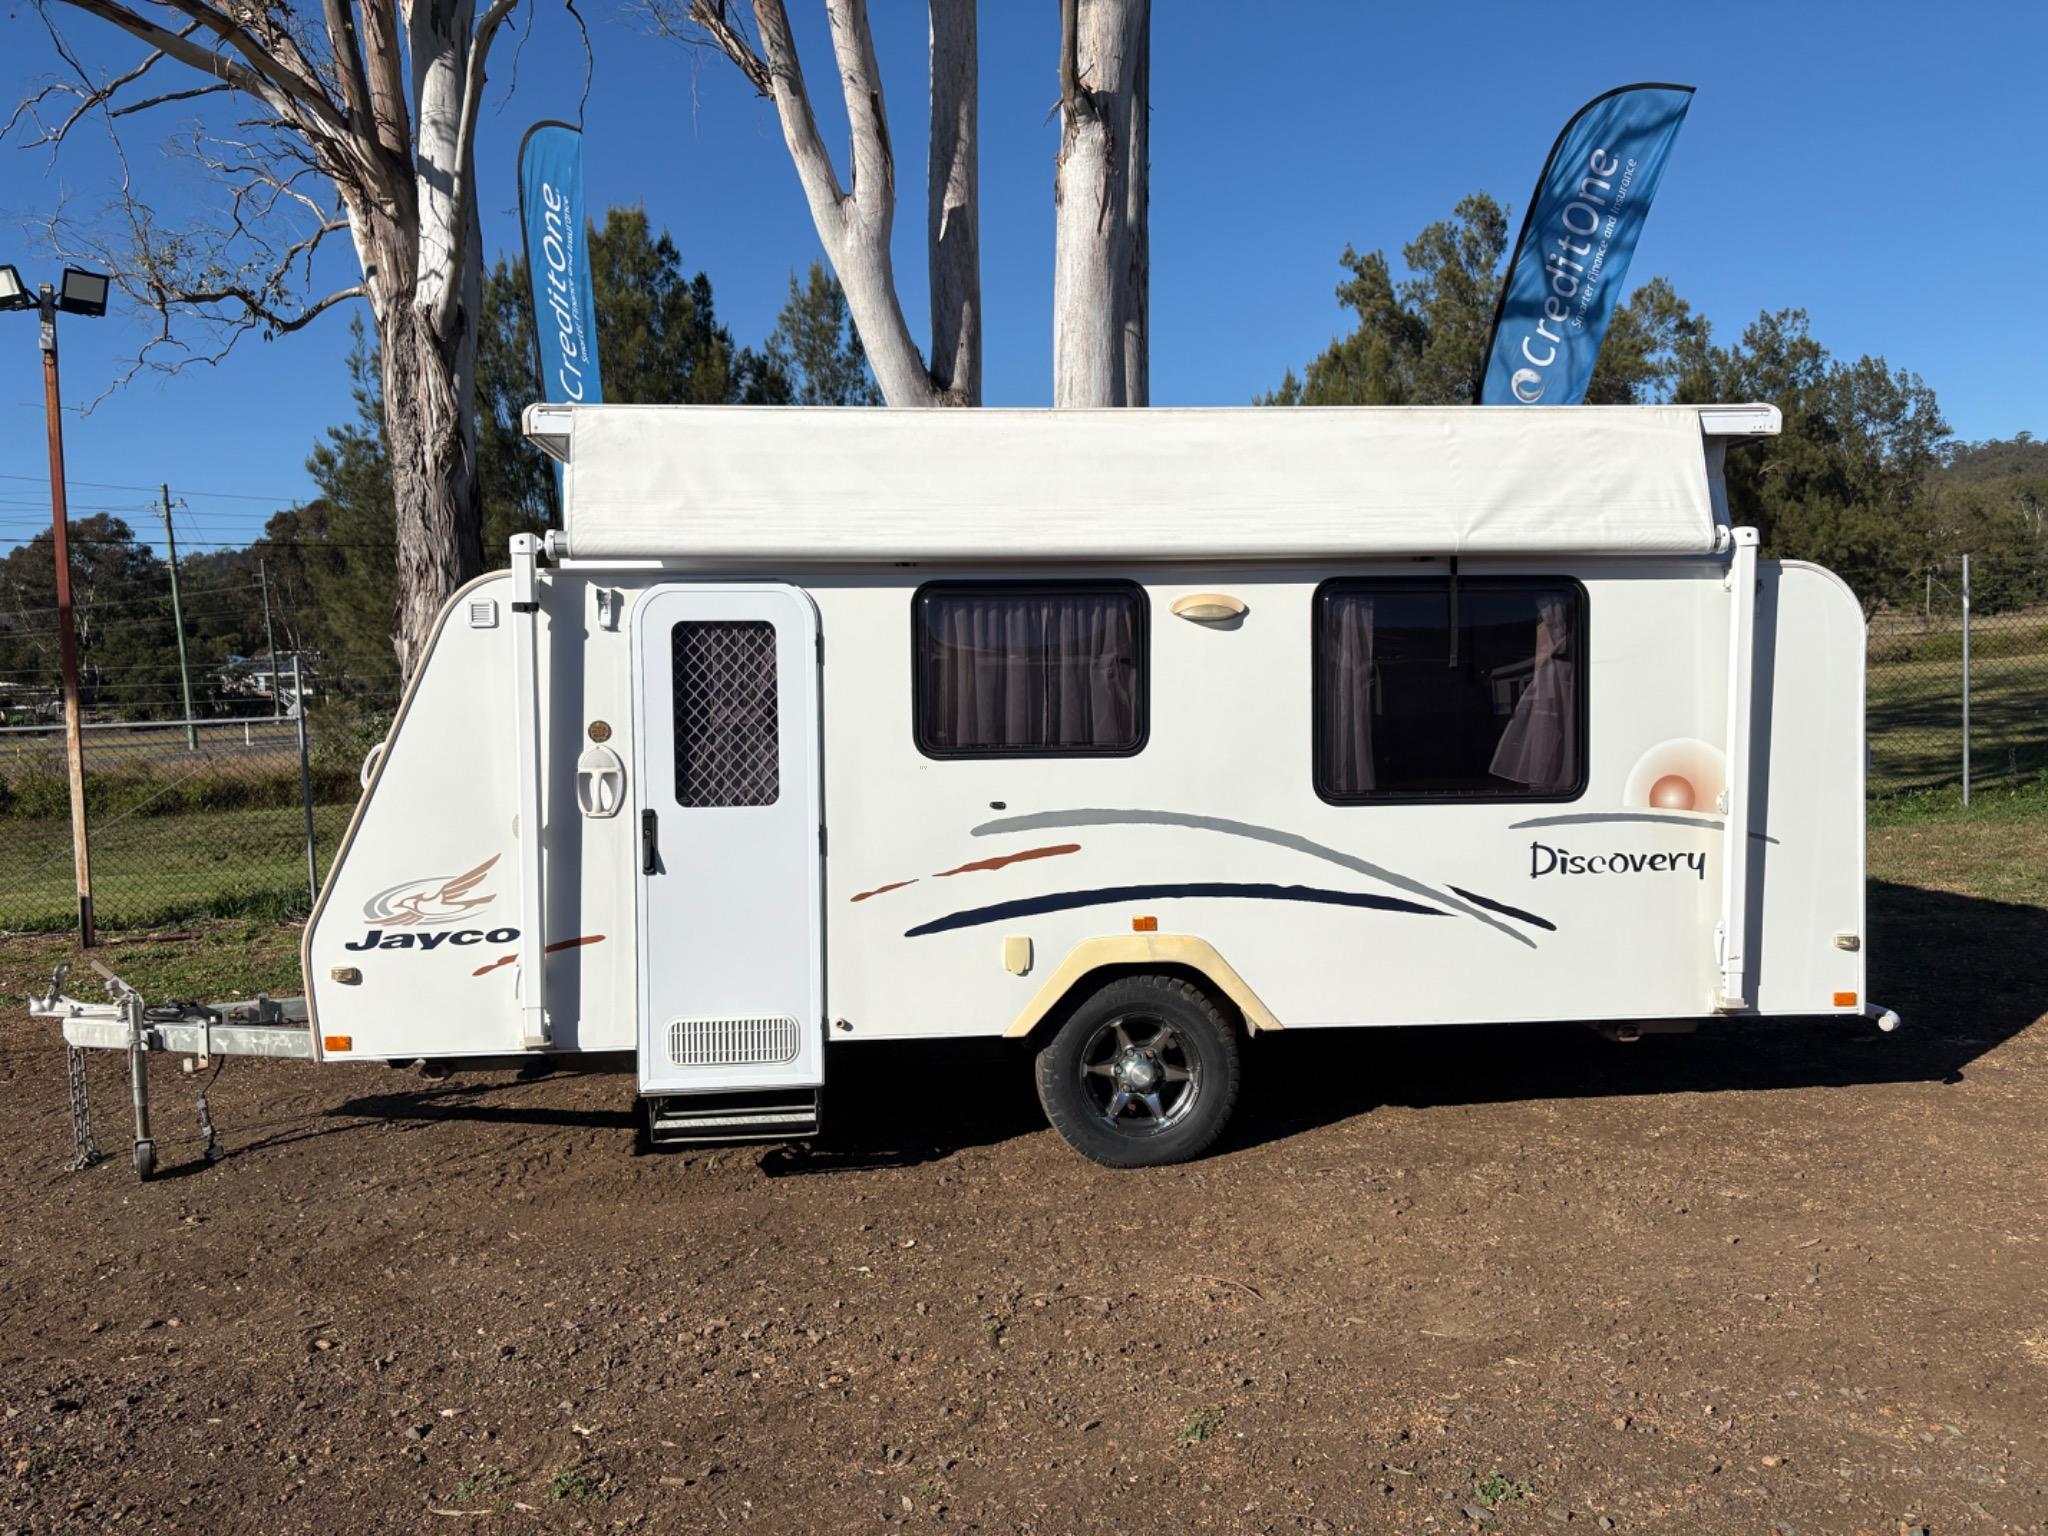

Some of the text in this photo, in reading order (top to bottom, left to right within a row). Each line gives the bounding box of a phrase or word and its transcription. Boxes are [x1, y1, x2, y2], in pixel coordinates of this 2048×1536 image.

[1571, 158, 1638, 329] Smarter Finance and Insurance
[1530, 841, 1706, 880] Discovery
[345, 927, 521, 951] Jayco
